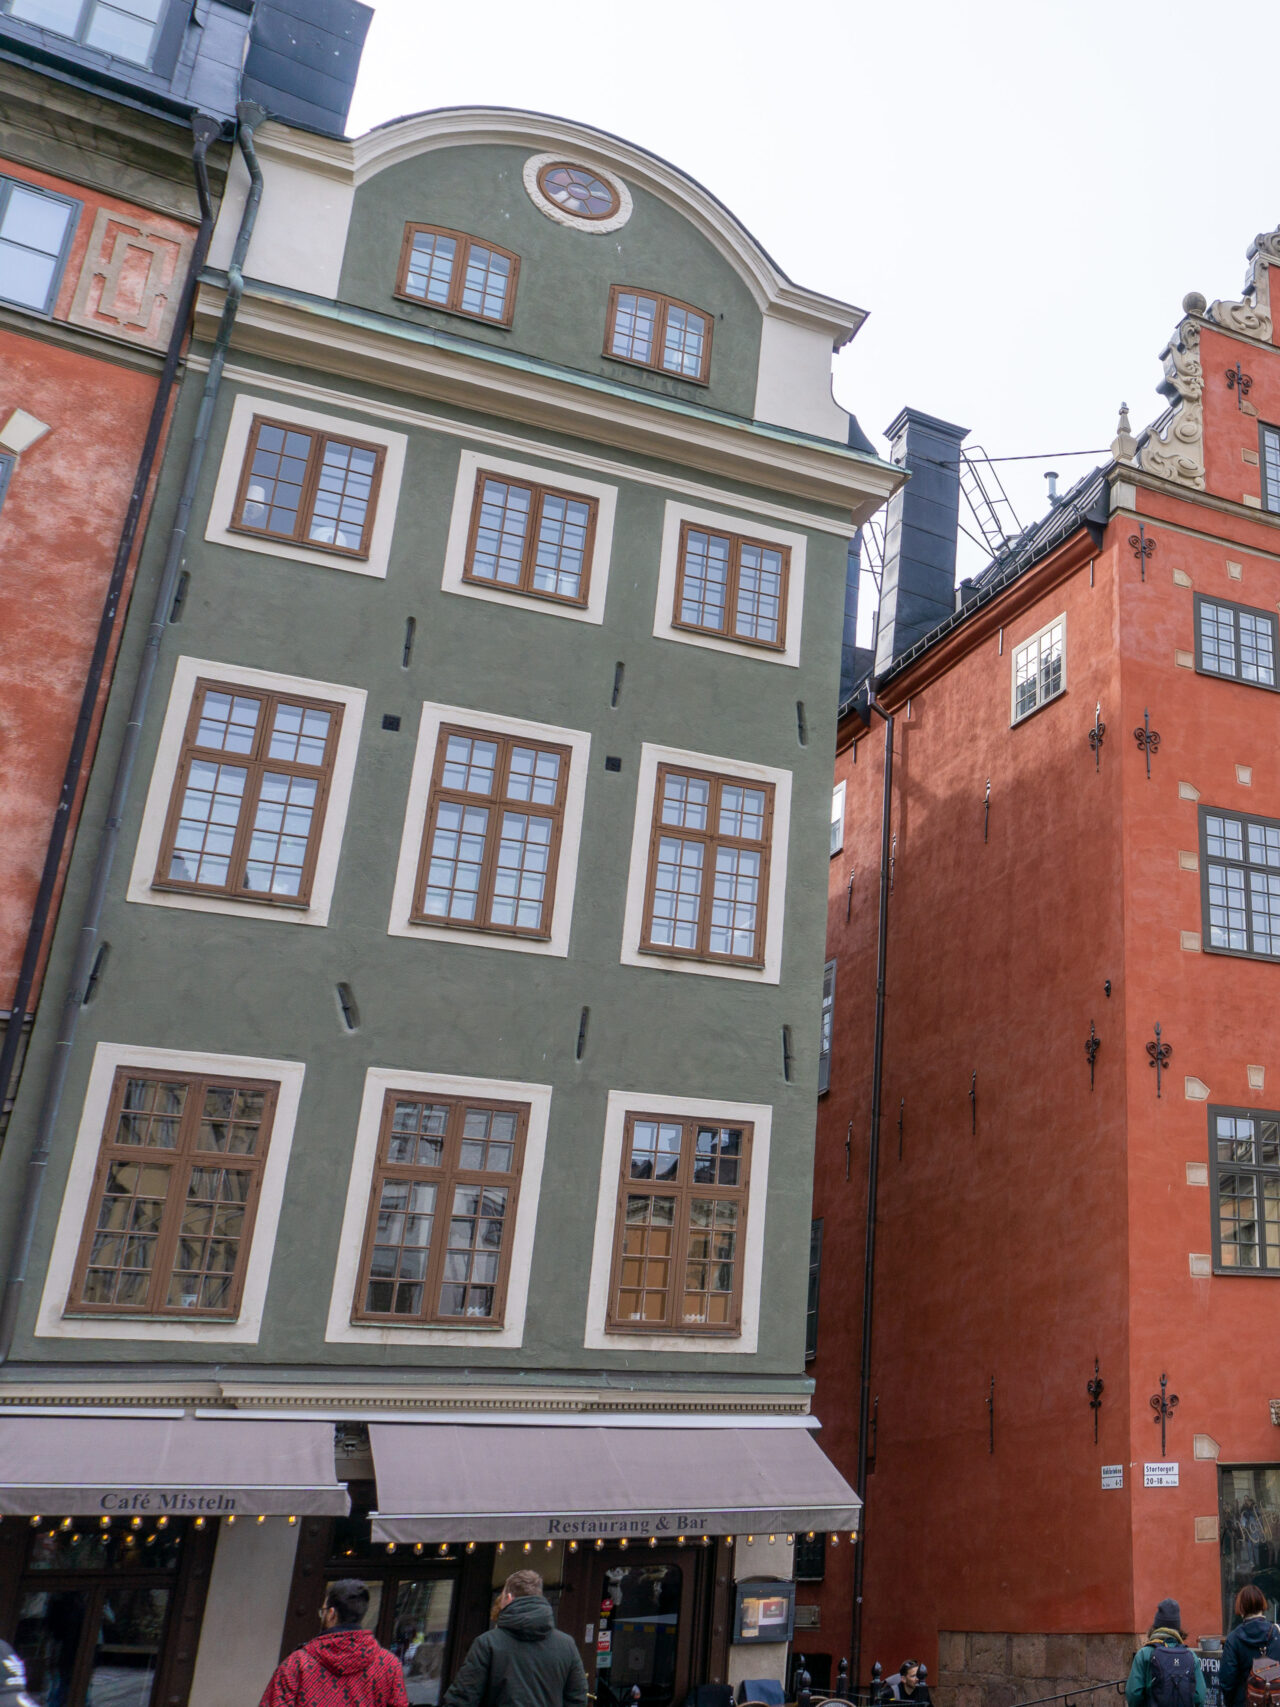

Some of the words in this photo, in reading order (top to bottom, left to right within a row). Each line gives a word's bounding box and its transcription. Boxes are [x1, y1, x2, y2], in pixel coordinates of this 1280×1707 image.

[1146, 1465, 1174, 1474] Stortorget
[100, 1493, 151, 1510] Café
[158, 1493, 236, 1510] Misteln
[547, 1518, 650, 1535] Restaurang
[655, 1516, 670, 1531] &
[677, 1515, 708, 1530] Bar
